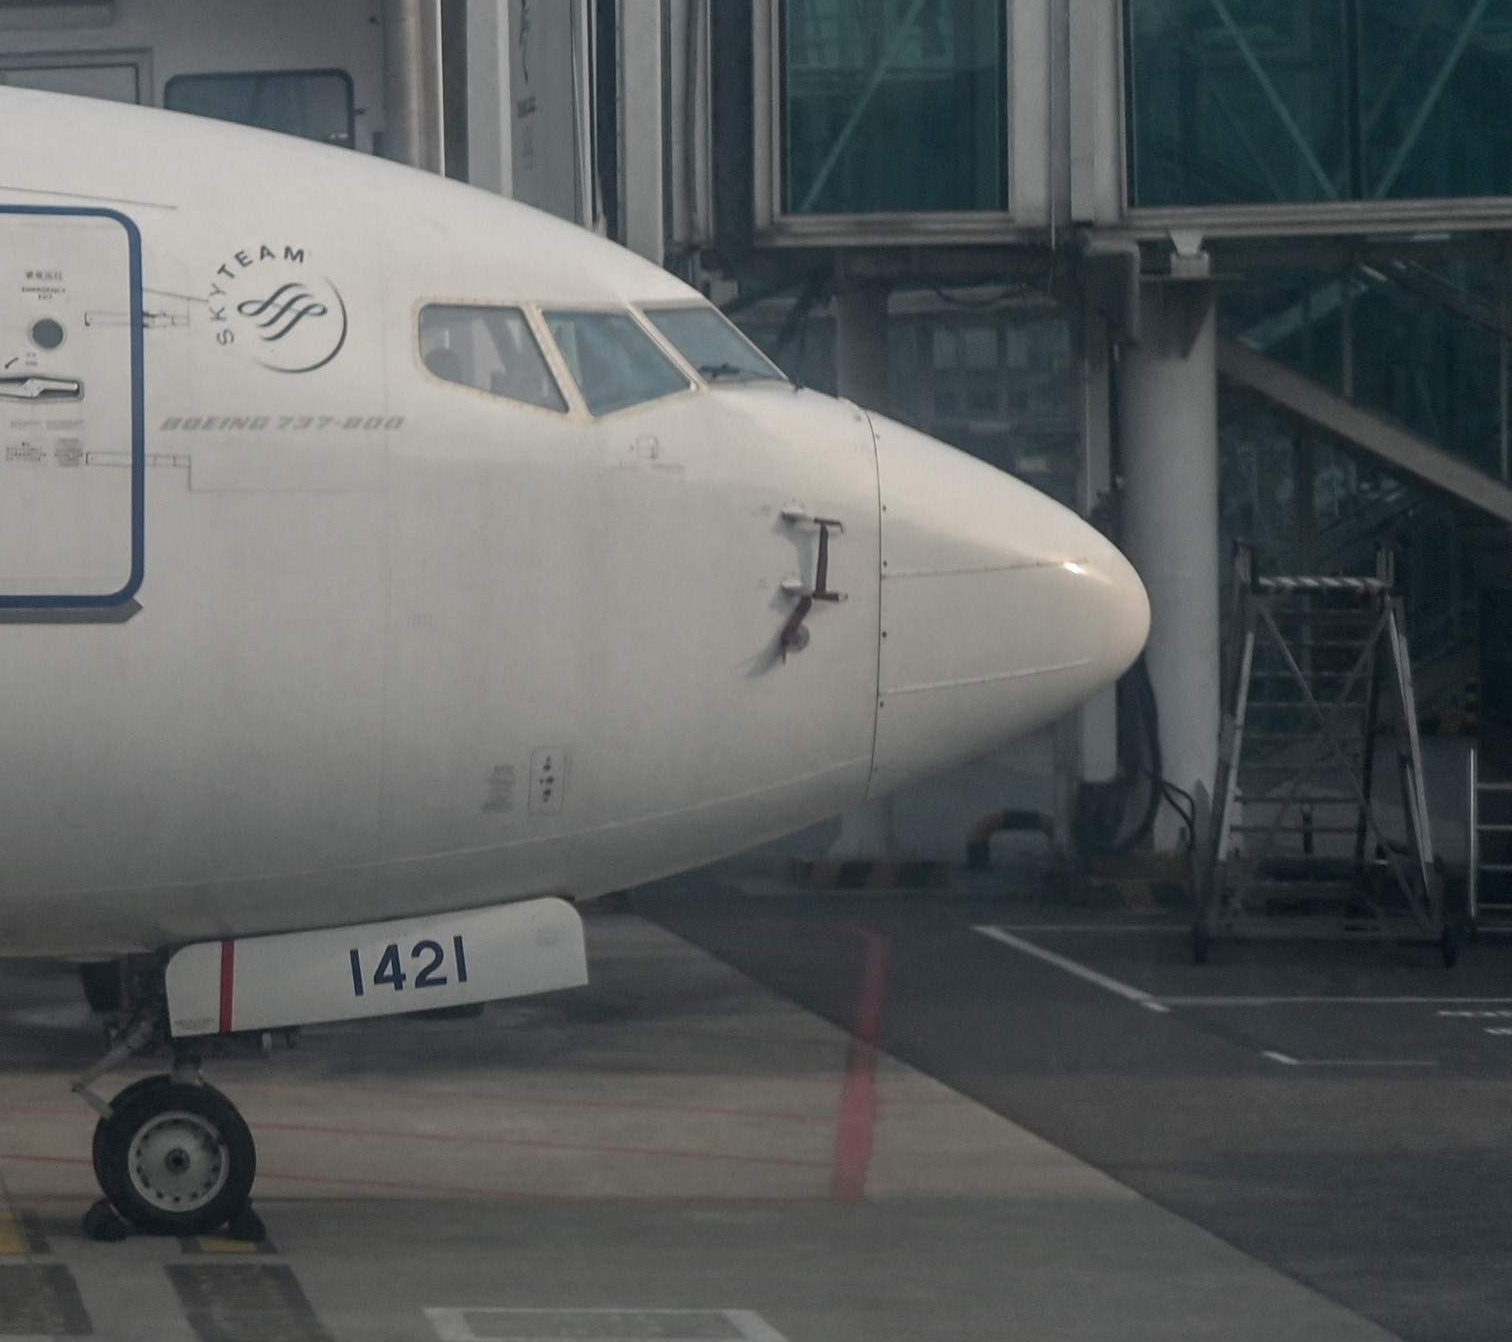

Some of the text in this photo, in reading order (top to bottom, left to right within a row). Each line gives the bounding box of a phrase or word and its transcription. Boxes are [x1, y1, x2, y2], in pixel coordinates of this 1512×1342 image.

[208, 244, 305, 346] SKYTEAM
[159, 415, 406, 432] BOEING 737-800
[349, 935, 468, 998] 1421
